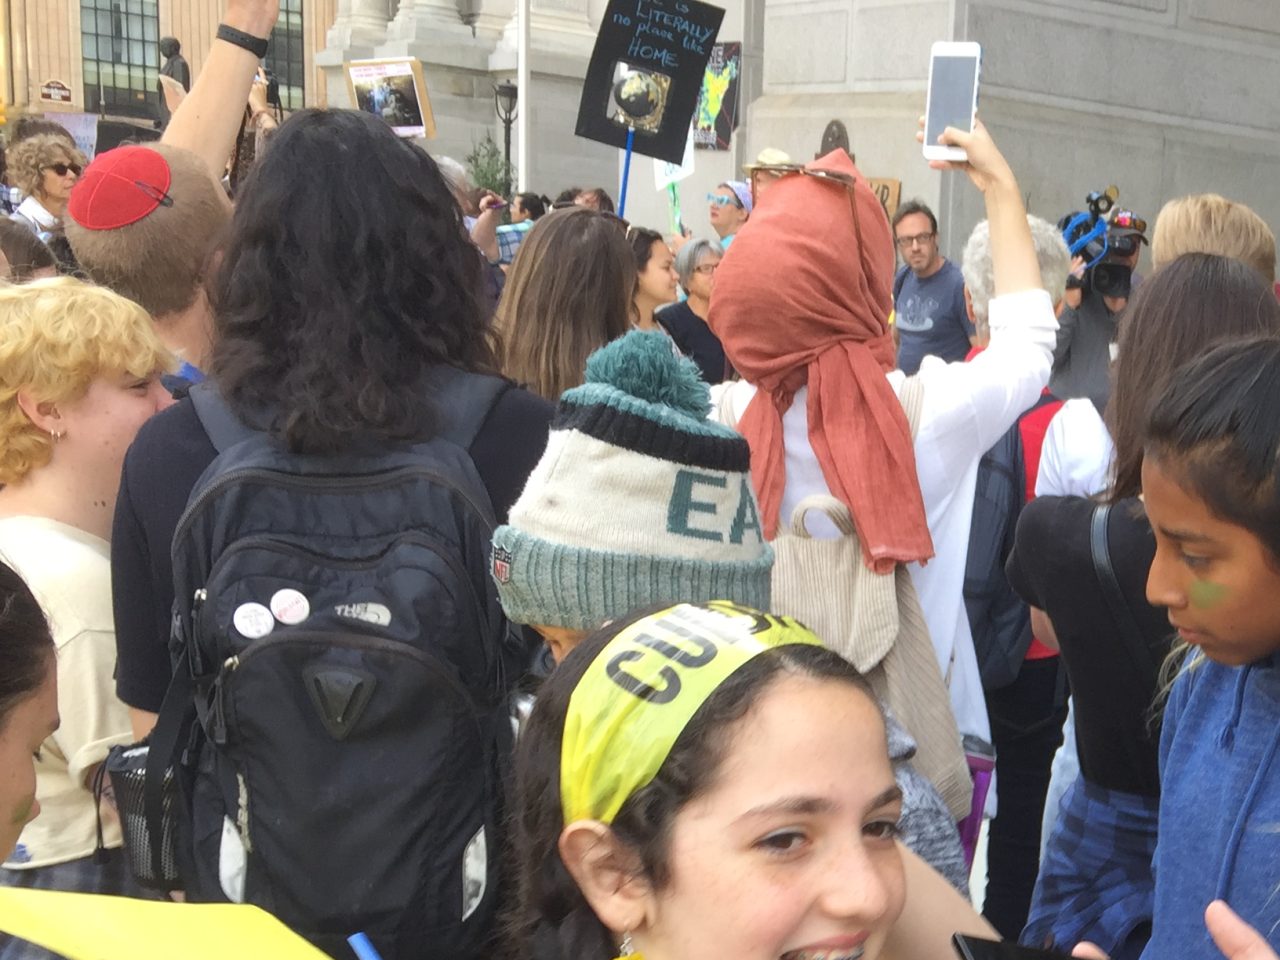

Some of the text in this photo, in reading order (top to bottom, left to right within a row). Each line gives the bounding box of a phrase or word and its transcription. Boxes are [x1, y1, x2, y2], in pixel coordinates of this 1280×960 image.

[613, 13, 631, 26] no
[683, 34, 704, 54] like
[636, 0, 714, 42] LITERALLY
[627, 37, 679, 67] HOME
